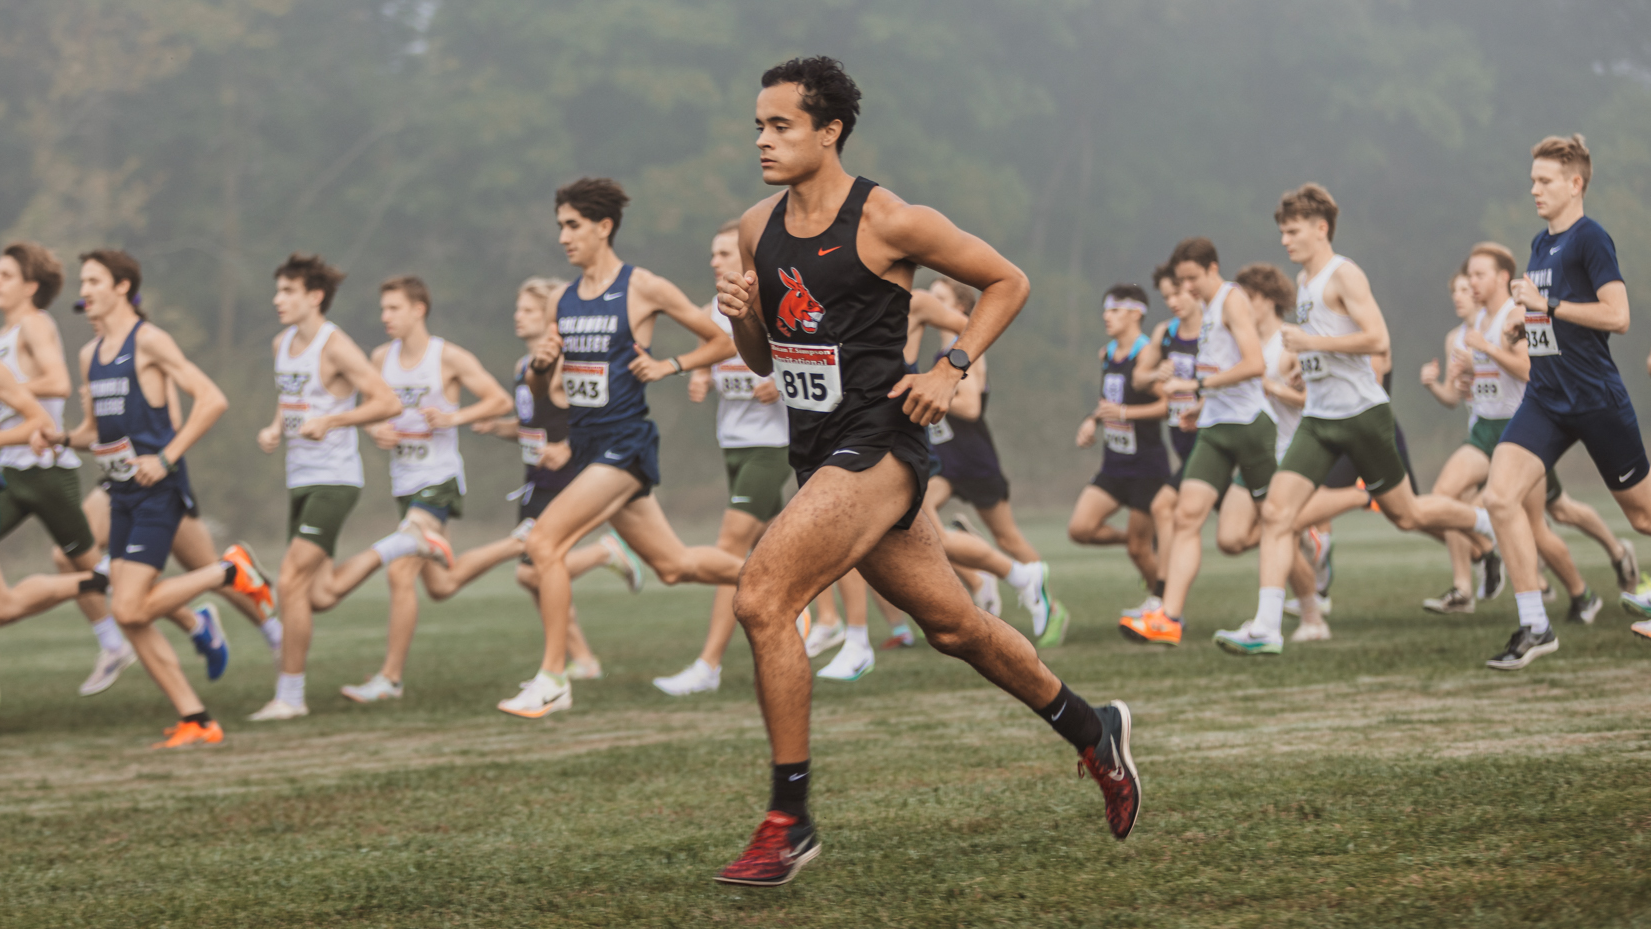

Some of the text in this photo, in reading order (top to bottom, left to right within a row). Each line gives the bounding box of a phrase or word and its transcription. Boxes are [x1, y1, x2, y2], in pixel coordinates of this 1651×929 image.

[774, 354, 827, 366] Invitational
[566, 379, 599, 399] 843
[783, 370, 828, 401] 815
